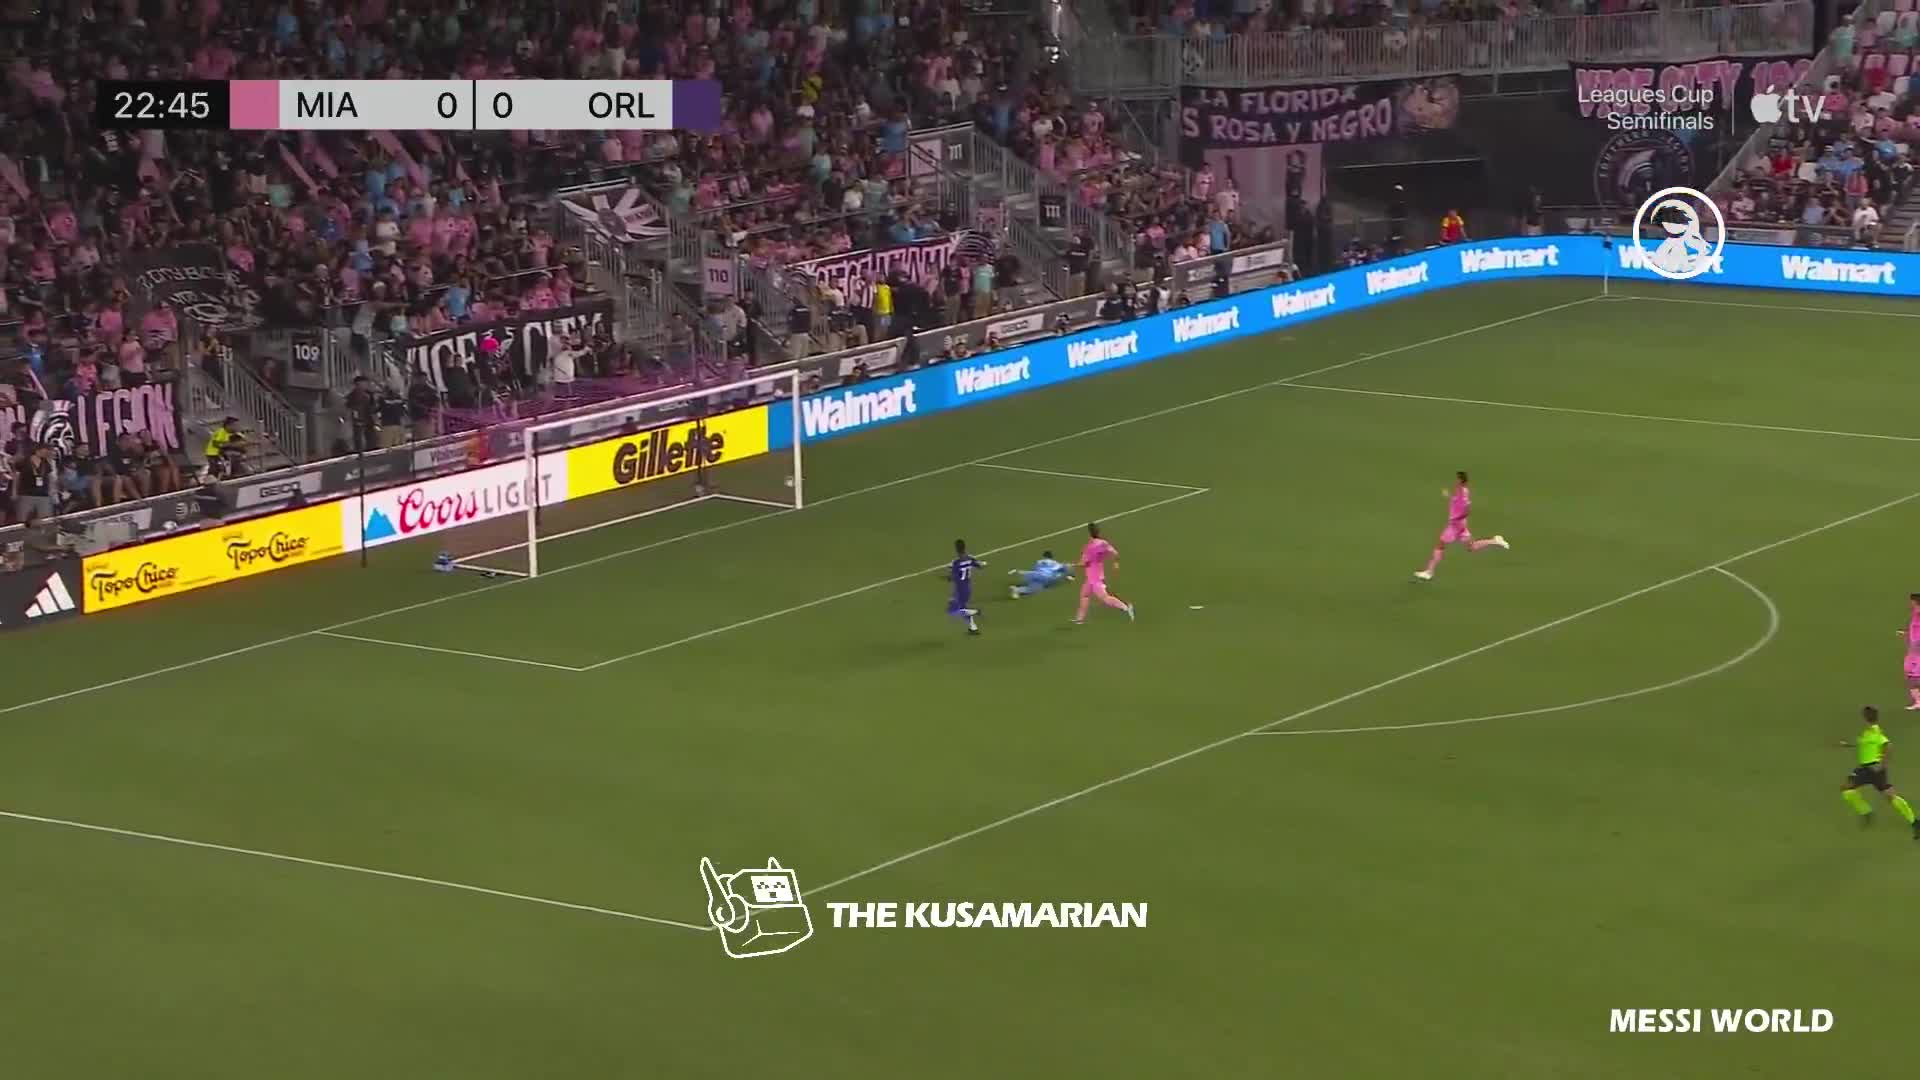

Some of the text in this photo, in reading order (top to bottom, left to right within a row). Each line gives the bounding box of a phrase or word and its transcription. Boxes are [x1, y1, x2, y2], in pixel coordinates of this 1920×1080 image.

[1208, 115, 1276, 143] ROSA
[1285, 121, 1302, 143] Y
[1311, 98, 1392, 142] NEGRO
[1461, 244, 1559, 273] Walmart
[1781, 255, 1896, 284] Walmart
[1366, 261, 1428, 295] Walmart
[1271, 283, 1335, 318] Walmart
[1172, 306, 1240, 343] Walmart
[294, 344, 320, 360] 109
[1067, 331, 1138, 368] Walmart
[955, 357, 1030, 395] Walmart
[801, 379, 916, 437] Walmart
[613, 429, 724, 484] Gillette
[398, 488, 478, 534] Coors
[227, 531, 310, 570] Topo Chico
[91, 562, 179, 602] Topo Chico
